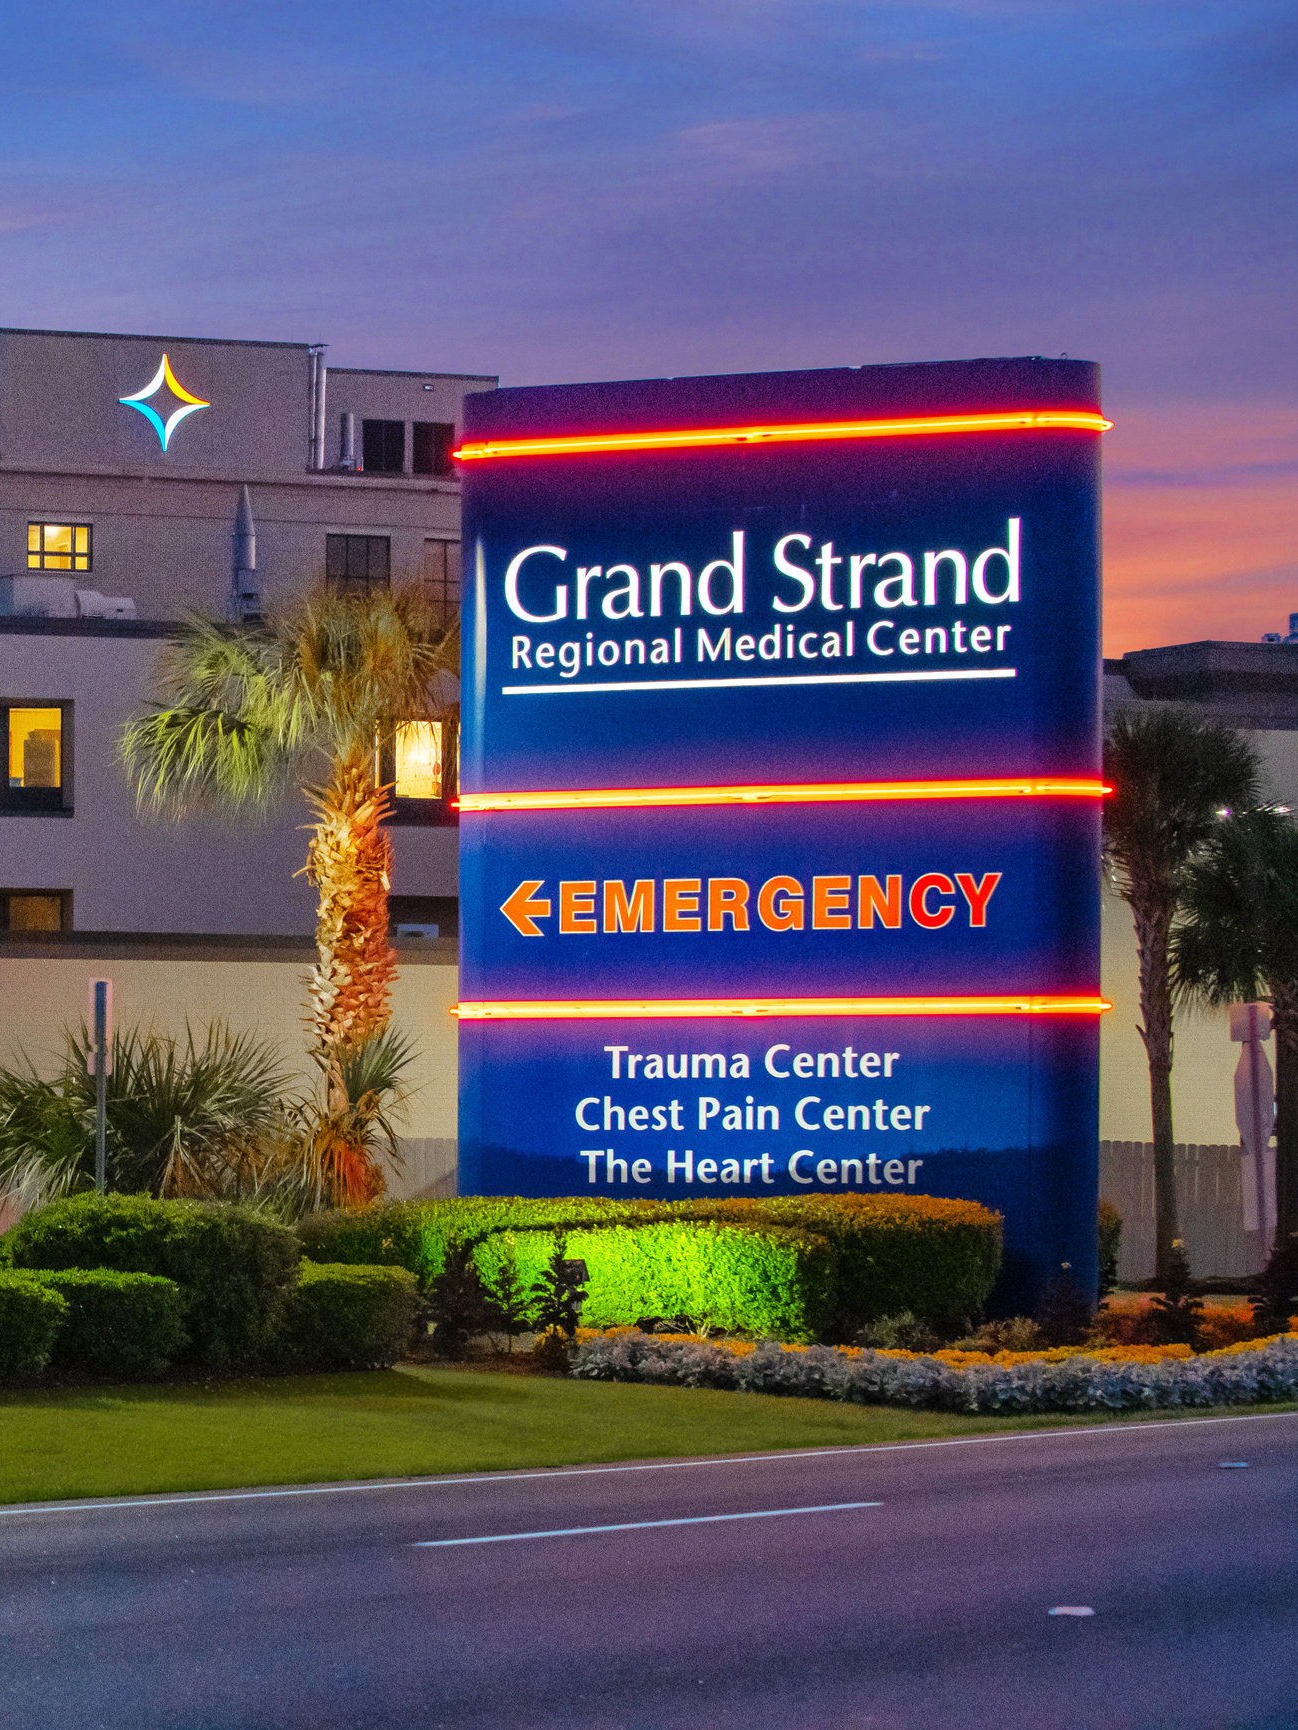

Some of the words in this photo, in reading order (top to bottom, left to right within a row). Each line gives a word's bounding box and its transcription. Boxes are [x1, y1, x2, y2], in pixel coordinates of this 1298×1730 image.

[504, 530, 745, 624] Grand
[772, 517, 1021, 614] Strand
[511, 628, 683, 678] Regional
[697, 620, 854, 663] Medical
[867, 620, 1013, 657] Center
[558, 871, 1003, 934] EMERGENCY
[603, 1043, 751, 1080] Trauma
[764, 1043, 901, 1080] Center
[574, 1095, 685, 1132] Chest
[697, 1095, 781, 1132] Pain
[794, 1095, 931, 1132] Center
[580, 1148, 653, 1185] The
[666, 1149, 775, 1185] Heart
[787, 1149, 924, 1186] Center
